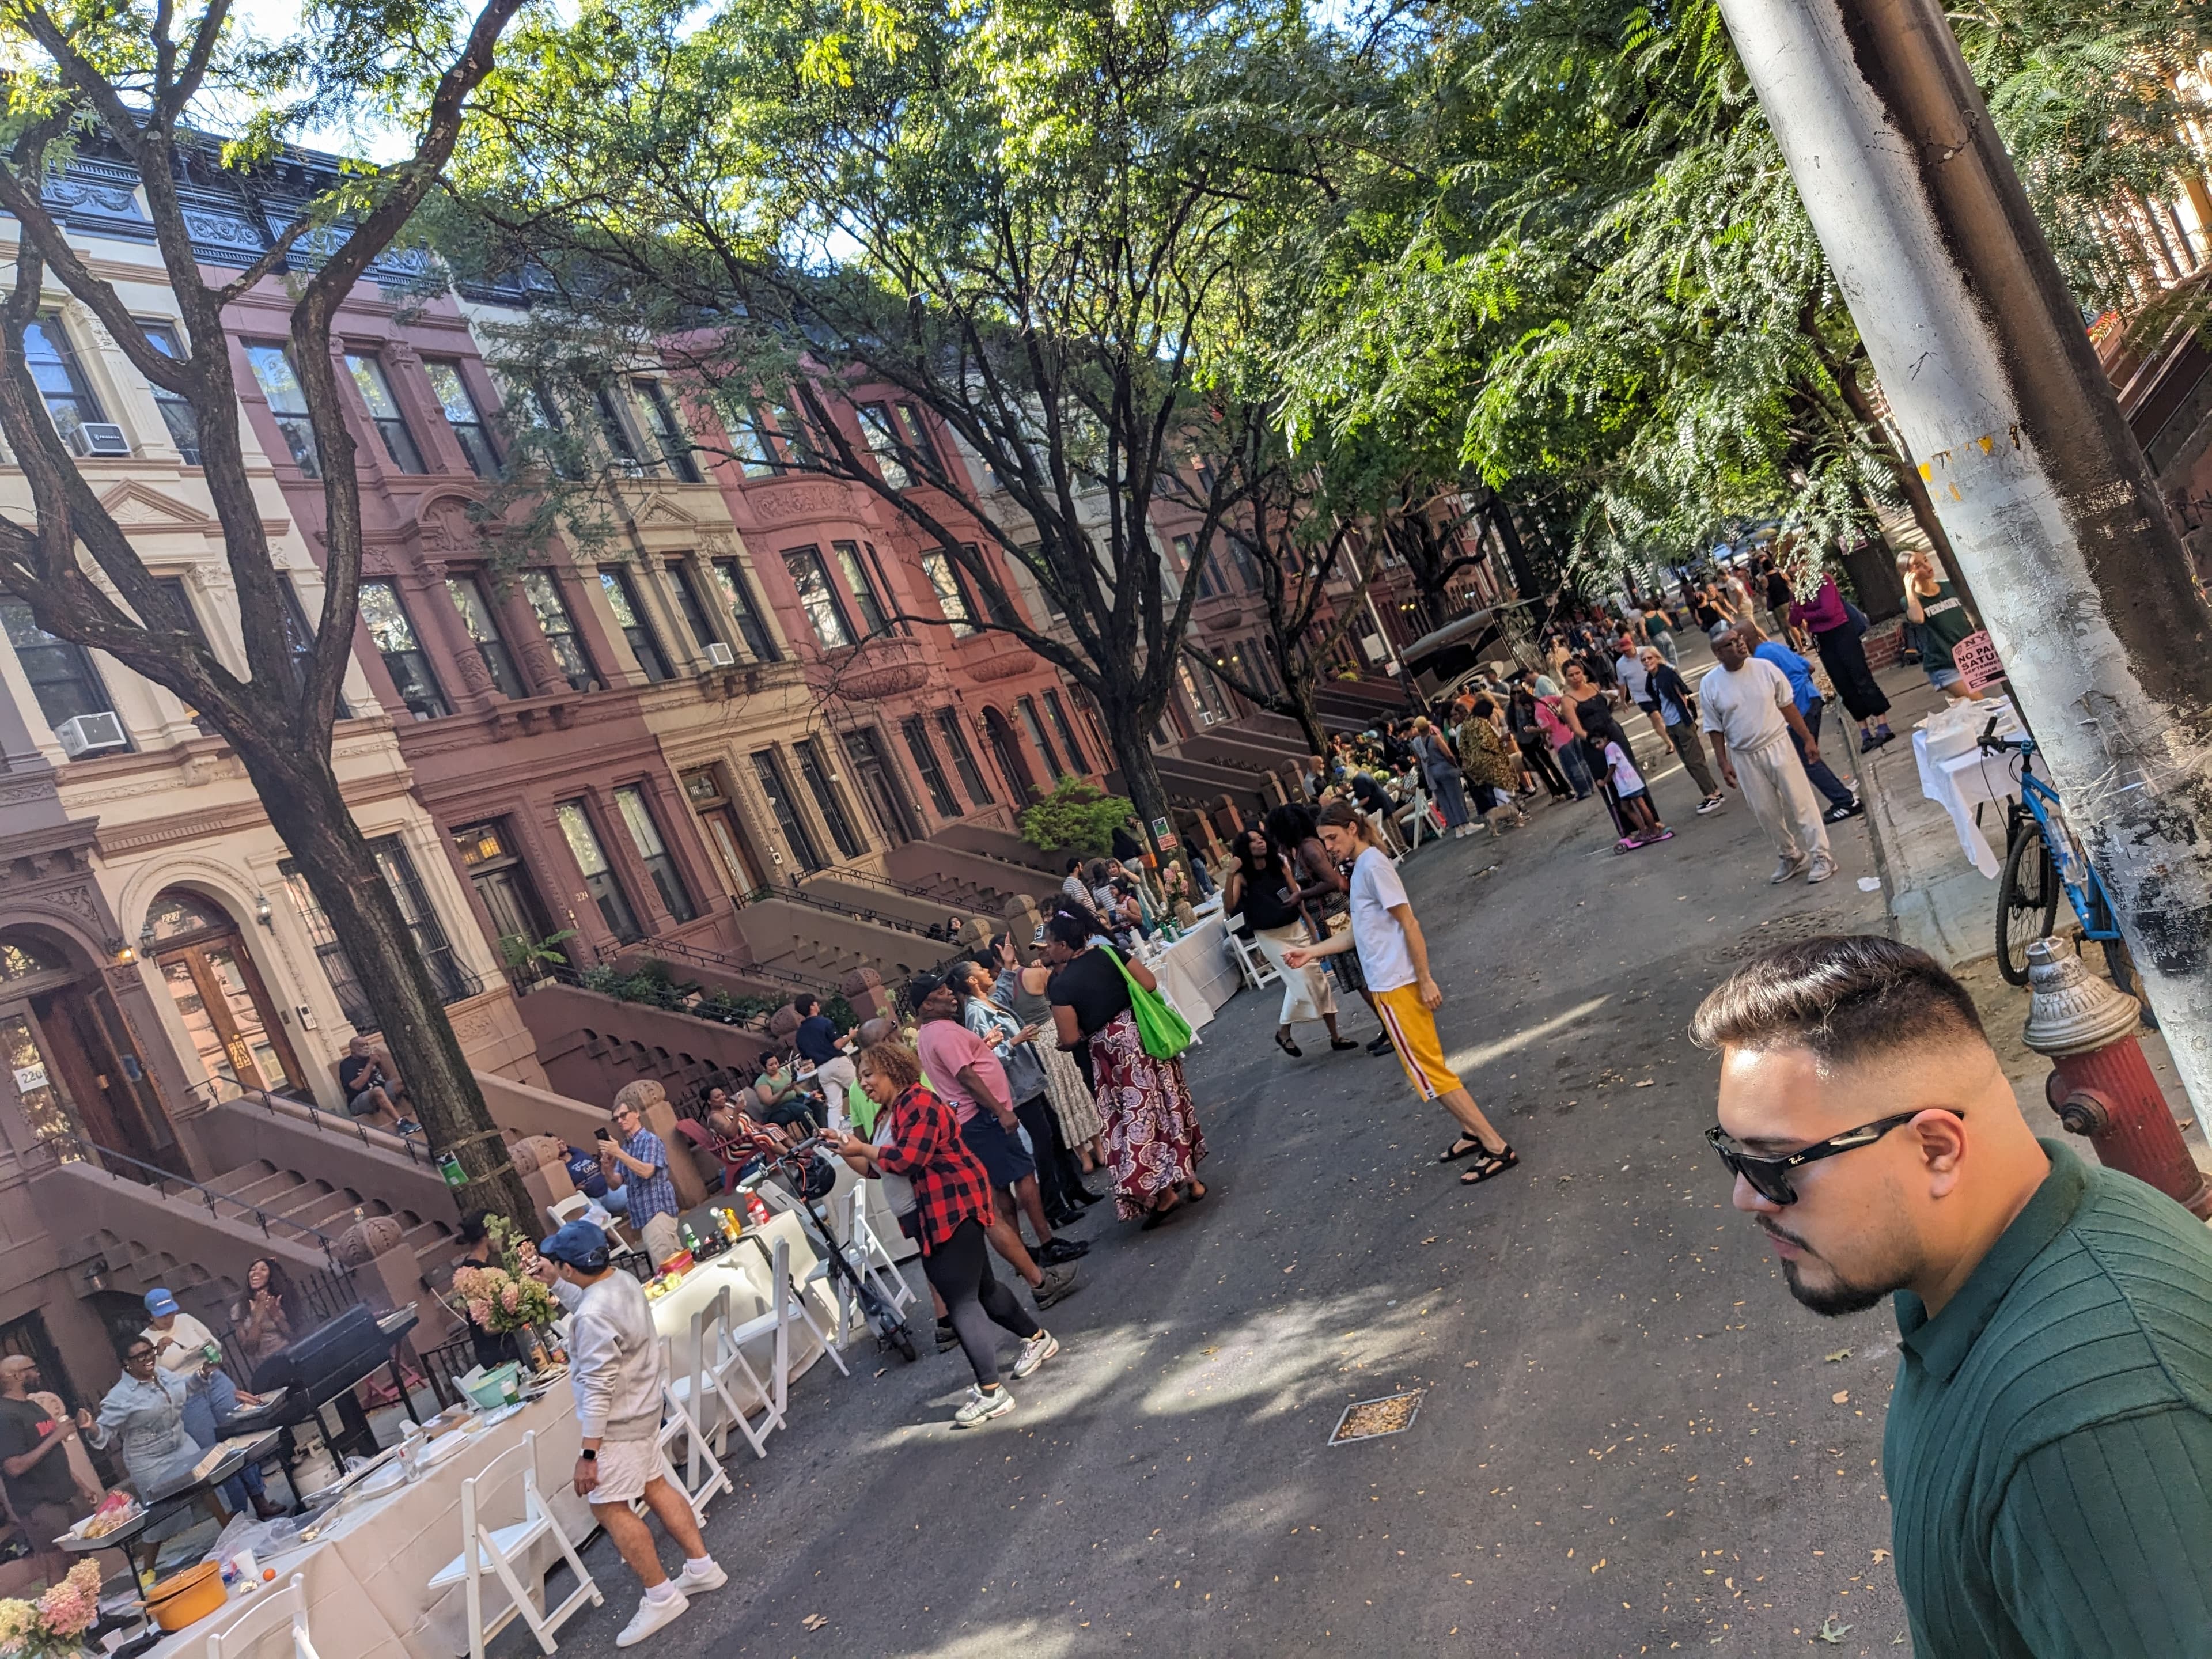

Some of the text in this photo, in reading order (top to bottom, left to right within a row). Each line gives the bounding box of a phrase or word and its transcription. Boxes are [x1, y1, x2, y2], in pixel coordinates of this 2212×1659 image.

[1958, 653, 1973, 664] NO
[164, 912, 178, 923] 222
[21, 1070, 43, 1084] 220
